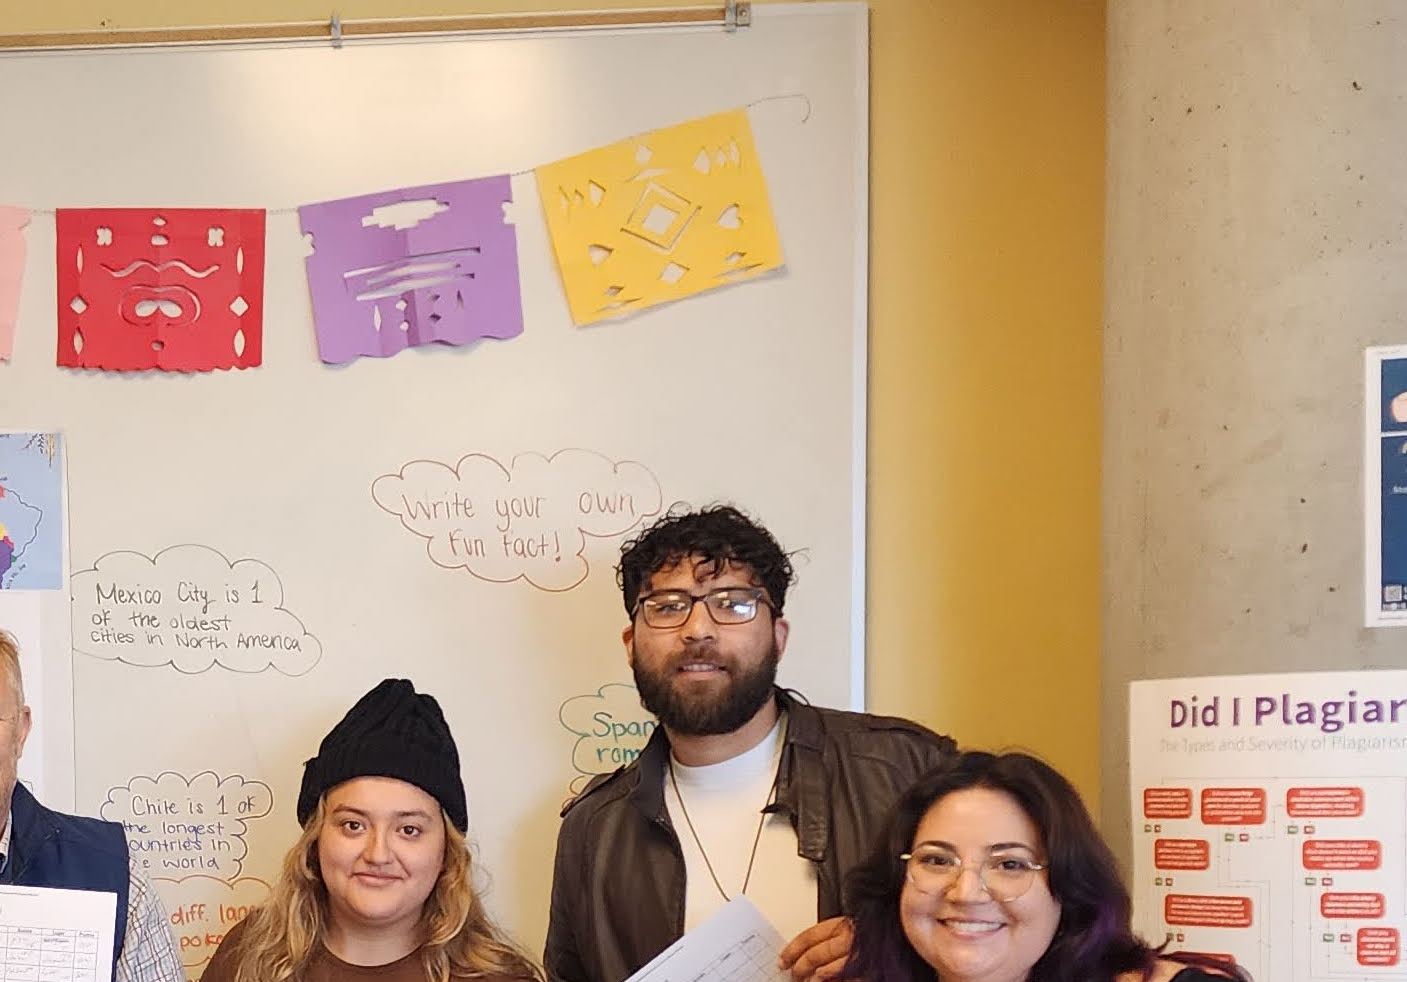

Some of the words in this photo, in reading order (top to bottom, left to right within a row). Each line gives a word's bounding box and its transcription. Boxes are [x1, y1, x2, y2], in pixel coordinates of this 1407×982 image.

[401, 492, 475, 521] Write
[495, 497, 547, 533] your
[577, 491, 637, 517] own
[96, 582, 162, 605] Mexico
[177, 580, 216, 614] City
[225, 584, 239, 603] is
[250, 579, 264, 604] 1
[128, 610, 160, 628] the
[169, 614, 232, 632] oldest
[90, 628, 134, 644] cities
[147, 630, 163, 645] in
[175, 633, 228, 650] North
[237, 631, 302, 653] America
[1170, 695, 1220, 729] Did
[1232, 697, 1241, 727] I
[1255, 691, 1407, 733] Plagiar
[1248, 736, 1306, 753] Severity
[1311, 735, 1327, 749] of
[132, 795, 179, 816] Chile
[187, 798, 204, 815] is
[217, 795, 229, 815] 1
[123, 819, 151, 834] the
[162, 821, 224, 842] longest
[128, 837, 203, 852] ountries
[163, 855, 221, 871] world
